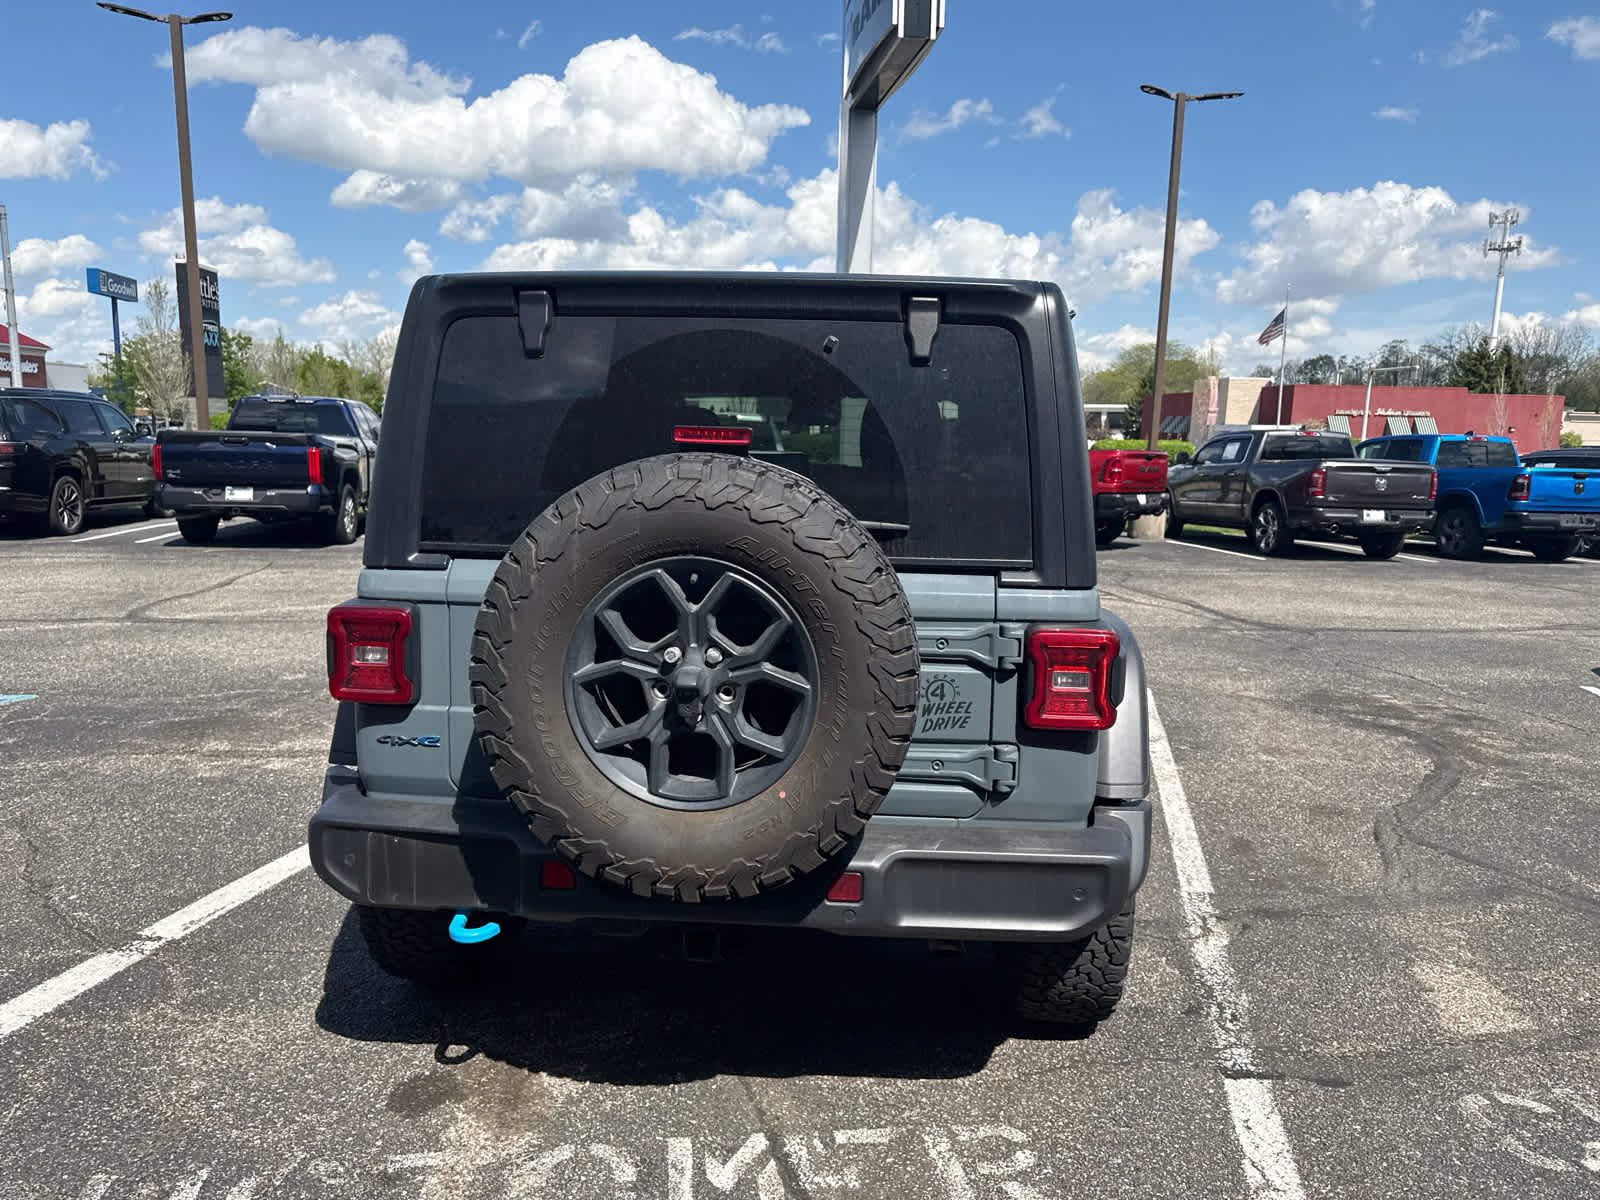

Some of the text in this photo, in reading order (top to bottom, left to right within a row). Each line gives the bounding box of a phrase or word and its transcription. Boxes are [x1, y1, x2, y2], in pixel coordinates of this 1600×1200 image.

[107, 278, 138, 297] Goodwill
[203, 331, 219, 347] AXX
[921, 701, 973, 717] WHEEL
[921, 715, 972, 733] DRIVE
